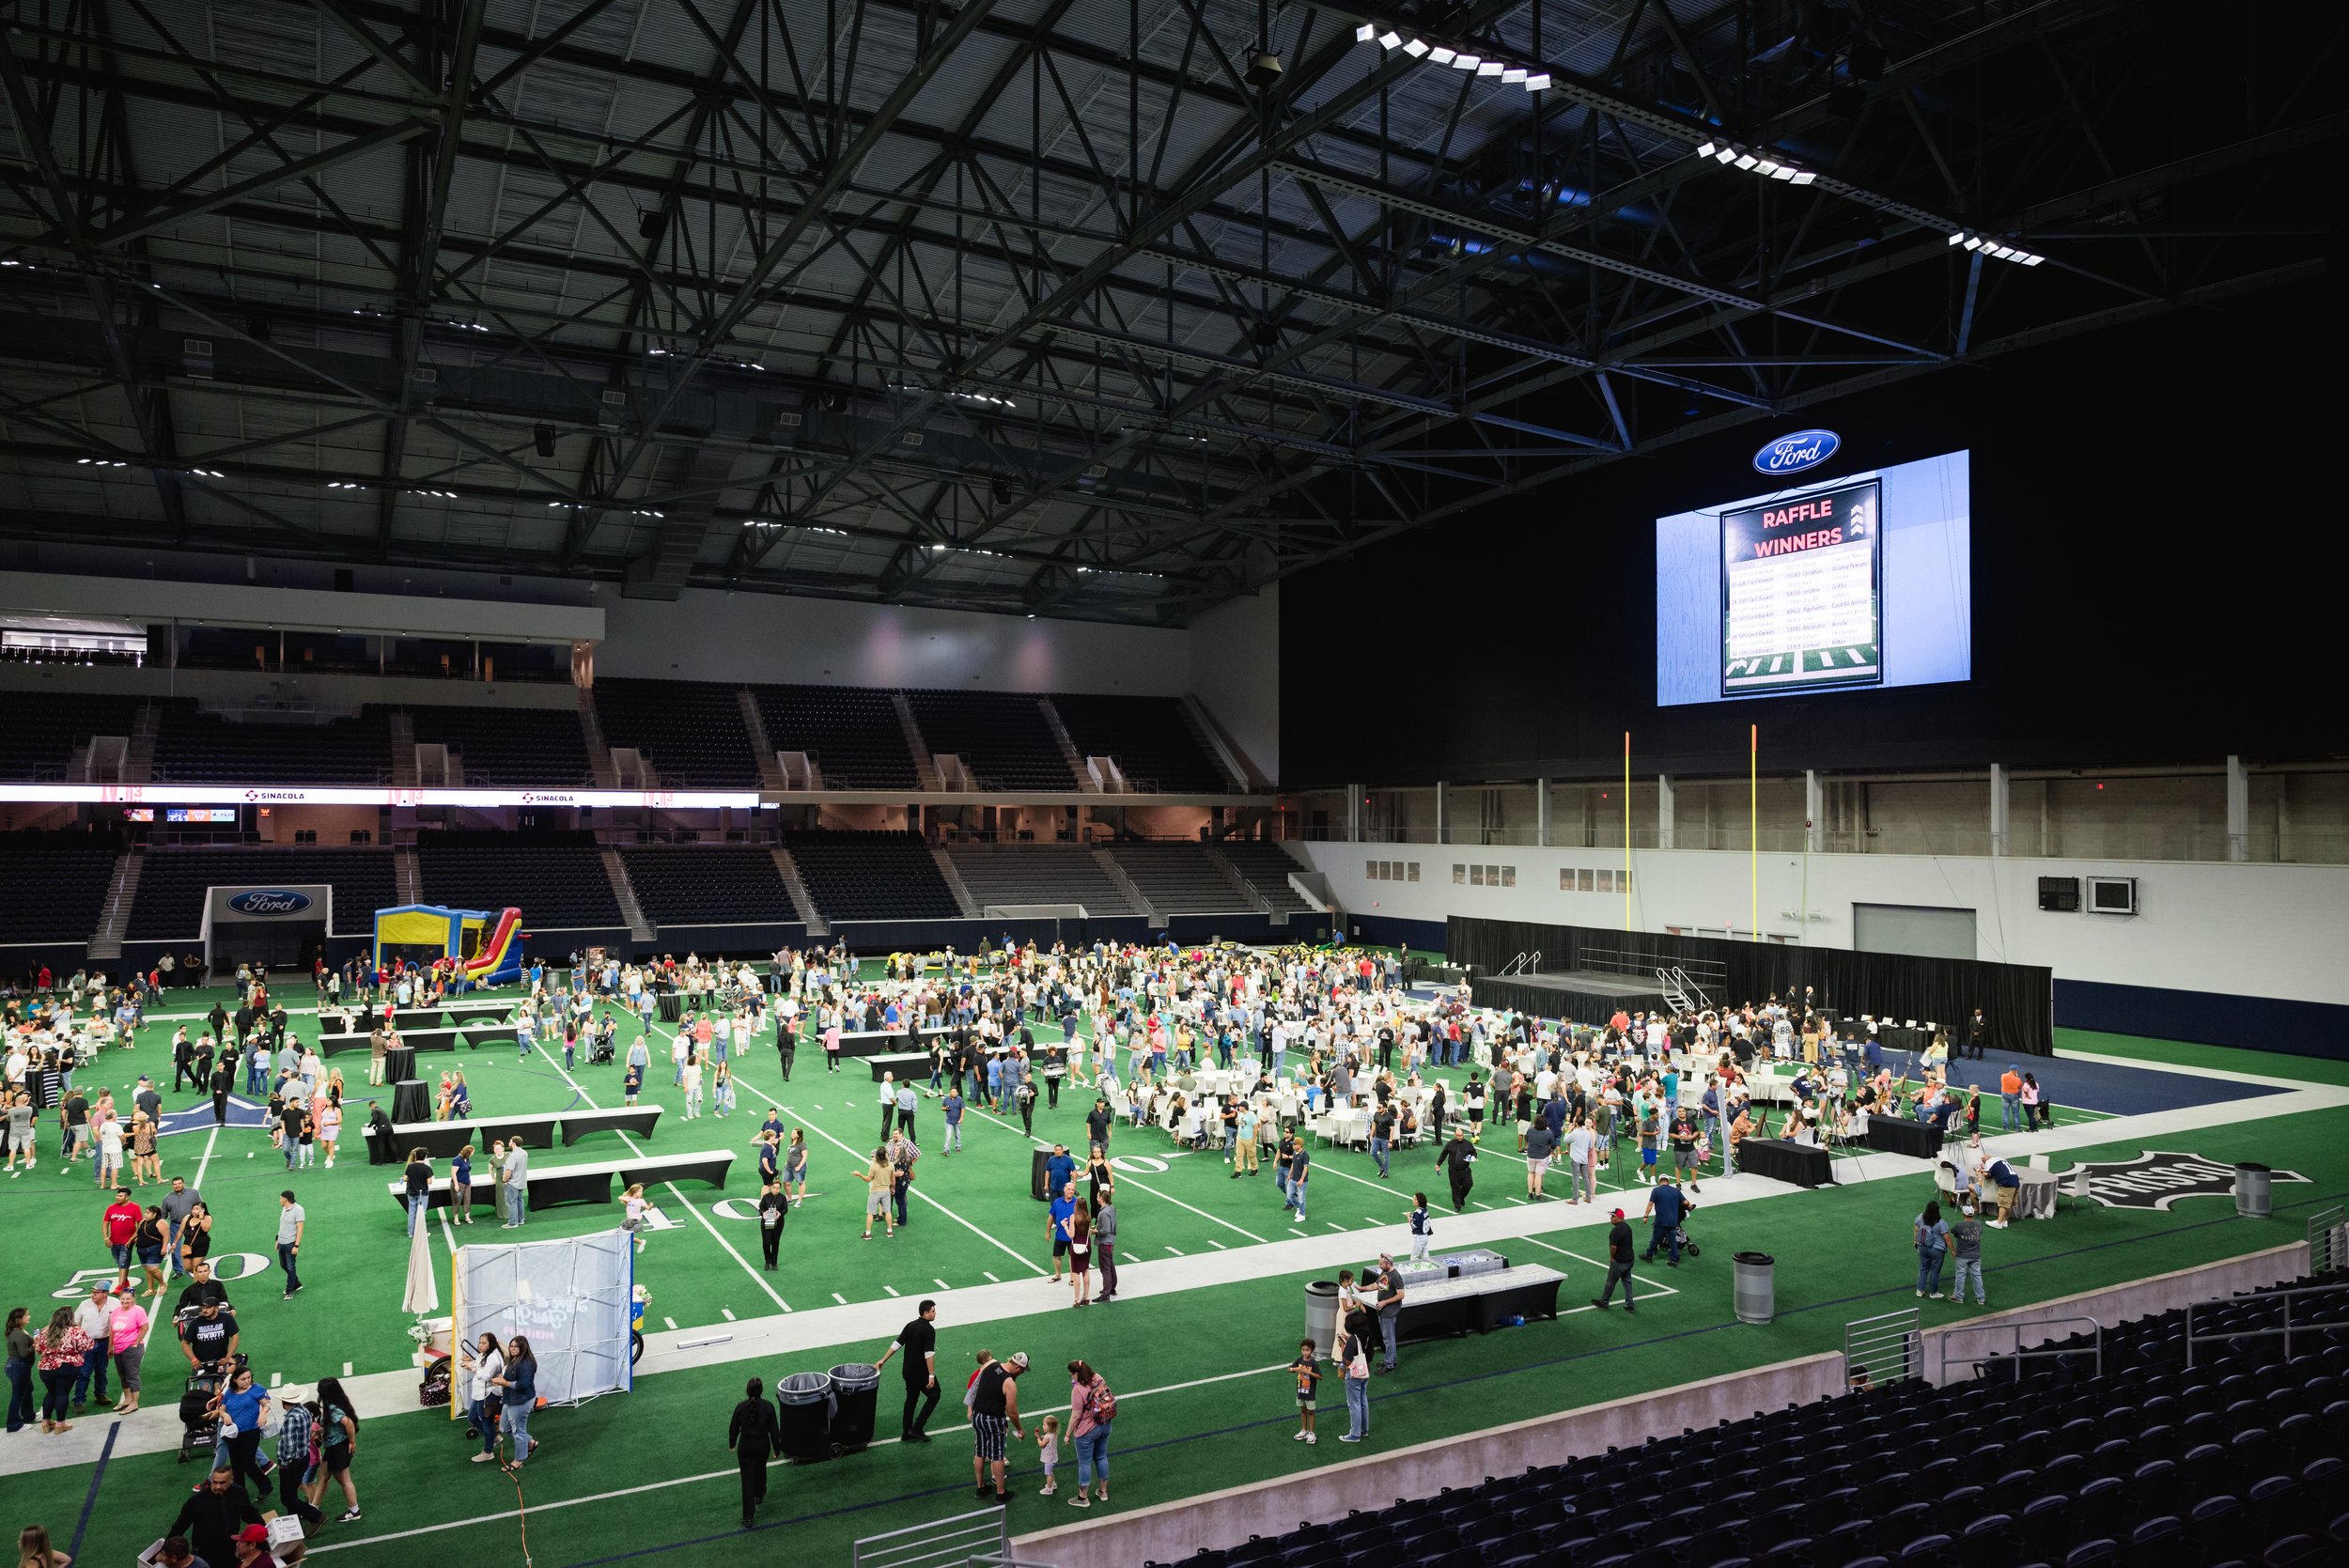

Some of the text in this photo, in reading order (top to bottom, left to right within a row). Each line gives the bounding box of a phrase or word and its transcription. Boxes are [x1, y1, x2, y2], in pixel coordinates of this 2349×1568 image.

[1770, 438, 1821, 469] Ford
[1763, 499, 1832, 529] RAFFLE
[1754, 527, 1843, 558] WINNERS
[244, 893, 296, 911] Ford
[2061, 1162, 2236, 1198] FRISCO
[197, 1330, 225, 1340] COWBOYS
